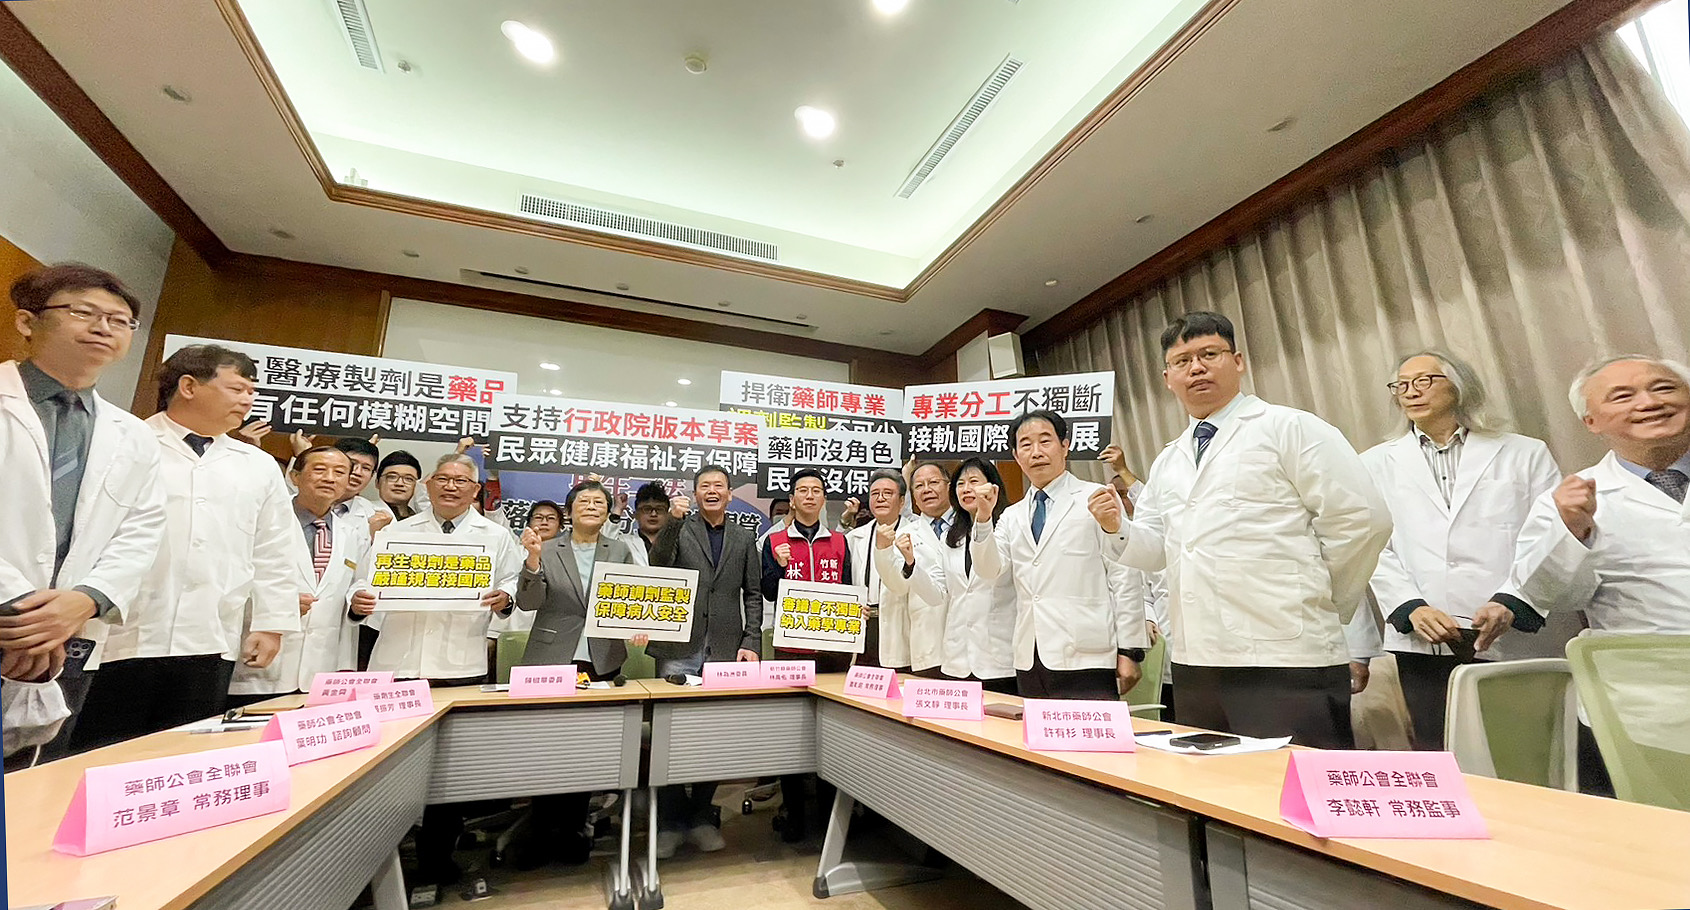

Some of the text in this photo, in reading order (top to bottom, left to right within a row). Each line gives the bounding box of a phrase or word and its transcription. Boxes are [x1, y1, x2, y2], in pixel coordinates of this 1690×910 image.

[252, 355, 504, 404] 醫療製劑是藥品
[741, 380, 886, 416] 捍衛藥師專業
[910, 383, 1103, 420] 專業分工不獨斷
[243, 391, 492, 437] 有任何模糊空間
[502, 402, 759, 446] 支持行政院版本草案
[767, 435, 894, 465] 藥師沒角色
[907, 421, 1100, 453] 接軌國際展
[495, 435, 759, 477] 民眾健康福祉有保障
[766, 466, 875, 495] 民沒保
[375, 553, 492, 572] 再生製劑是藥品
[371, 570, 491, 588] 嚴謹規管接國際
[596, 582, 692, 605] 藥師調劑監製
[594, 600, 689, 623] 保障病人安全
[297, 710, 363, 731] 藥師公會全聯會
[1042, 711, 1112, 722] 新北市藥師公會
[1082, 727, 1116, 739] 理事長
[124, 759, 258, 797] 藥師公會全聯會
[1326, 769, 1439, 788] 藥師公會全聯會
[113, 780, 270, 829] 范景章 常務理事
[1388, 799, 1461, 819] 常務監事
